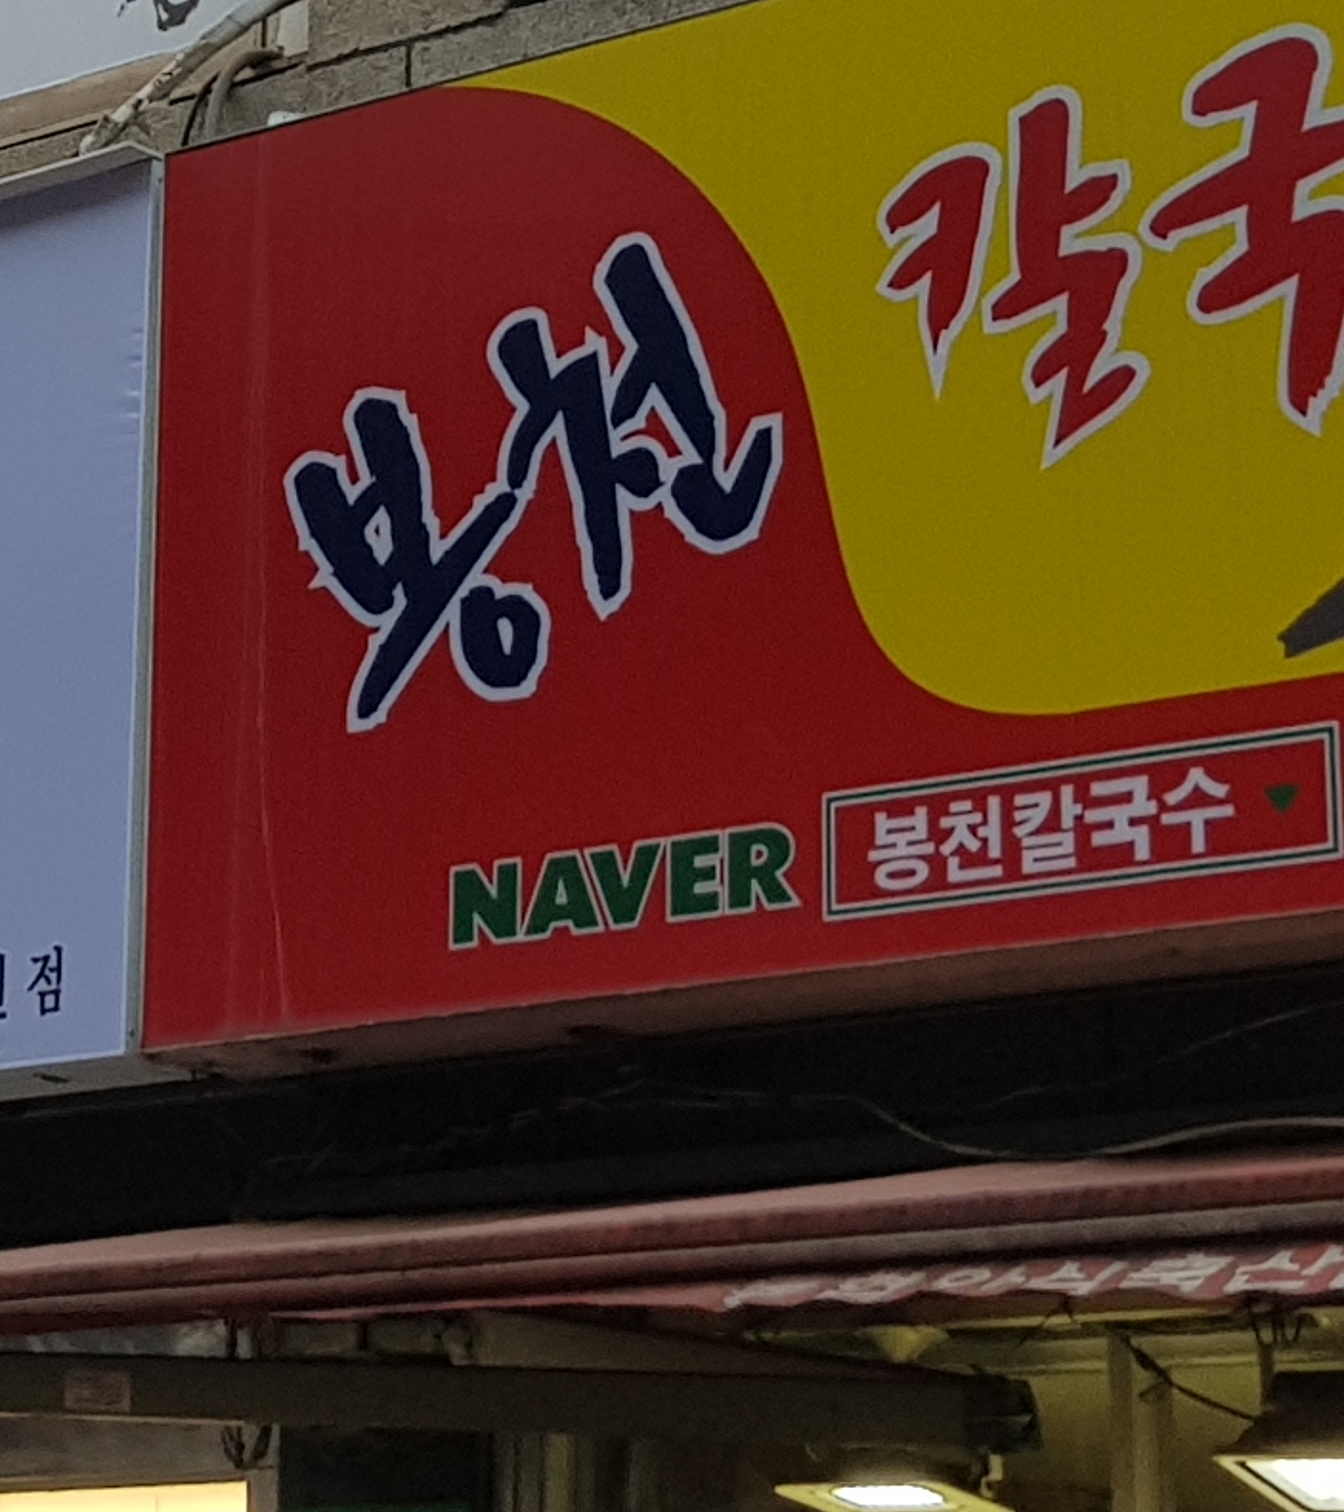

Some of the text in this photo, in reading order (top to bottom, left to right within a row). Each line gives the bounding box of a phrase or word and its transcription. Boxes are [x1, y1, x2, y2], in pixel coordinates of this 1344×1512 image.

[283, 231, 784, 733] 봉천
[448, 822, 801, 951] NAVER
[867, 766, 1237, 889] 봉천칼국수
